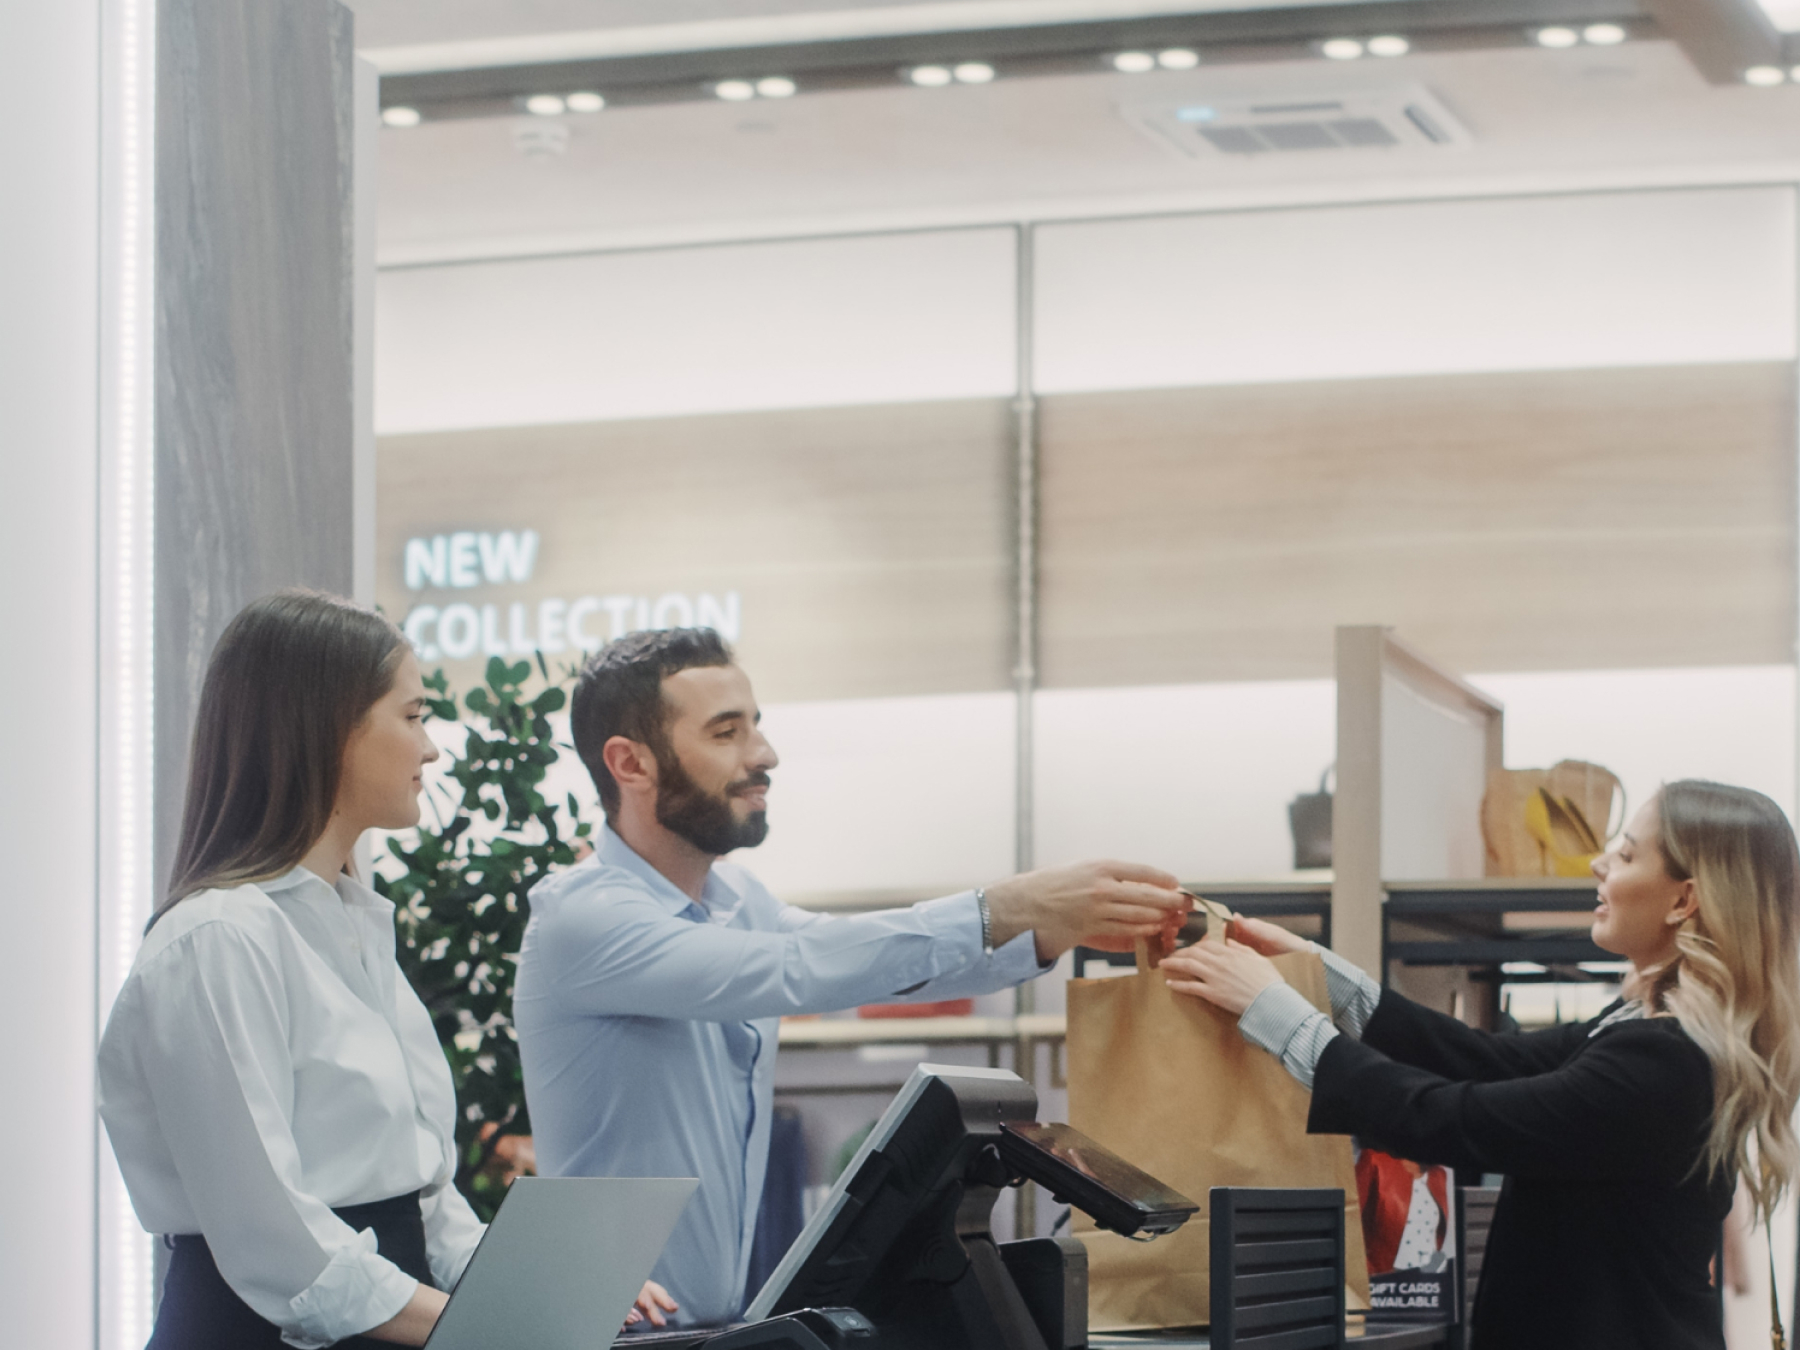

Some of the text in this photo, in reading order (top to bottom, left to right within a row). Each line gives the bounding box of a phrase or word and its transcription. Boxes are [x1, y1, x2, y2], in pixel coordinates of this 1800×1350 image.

[404, 529, 540, 590] NEW
[402, 591, 742, 661] COLLECTION
[1370, 1296, 1439, 1309] AVAILABLE
[1399, 1282, 1440, 1295] CARDS
